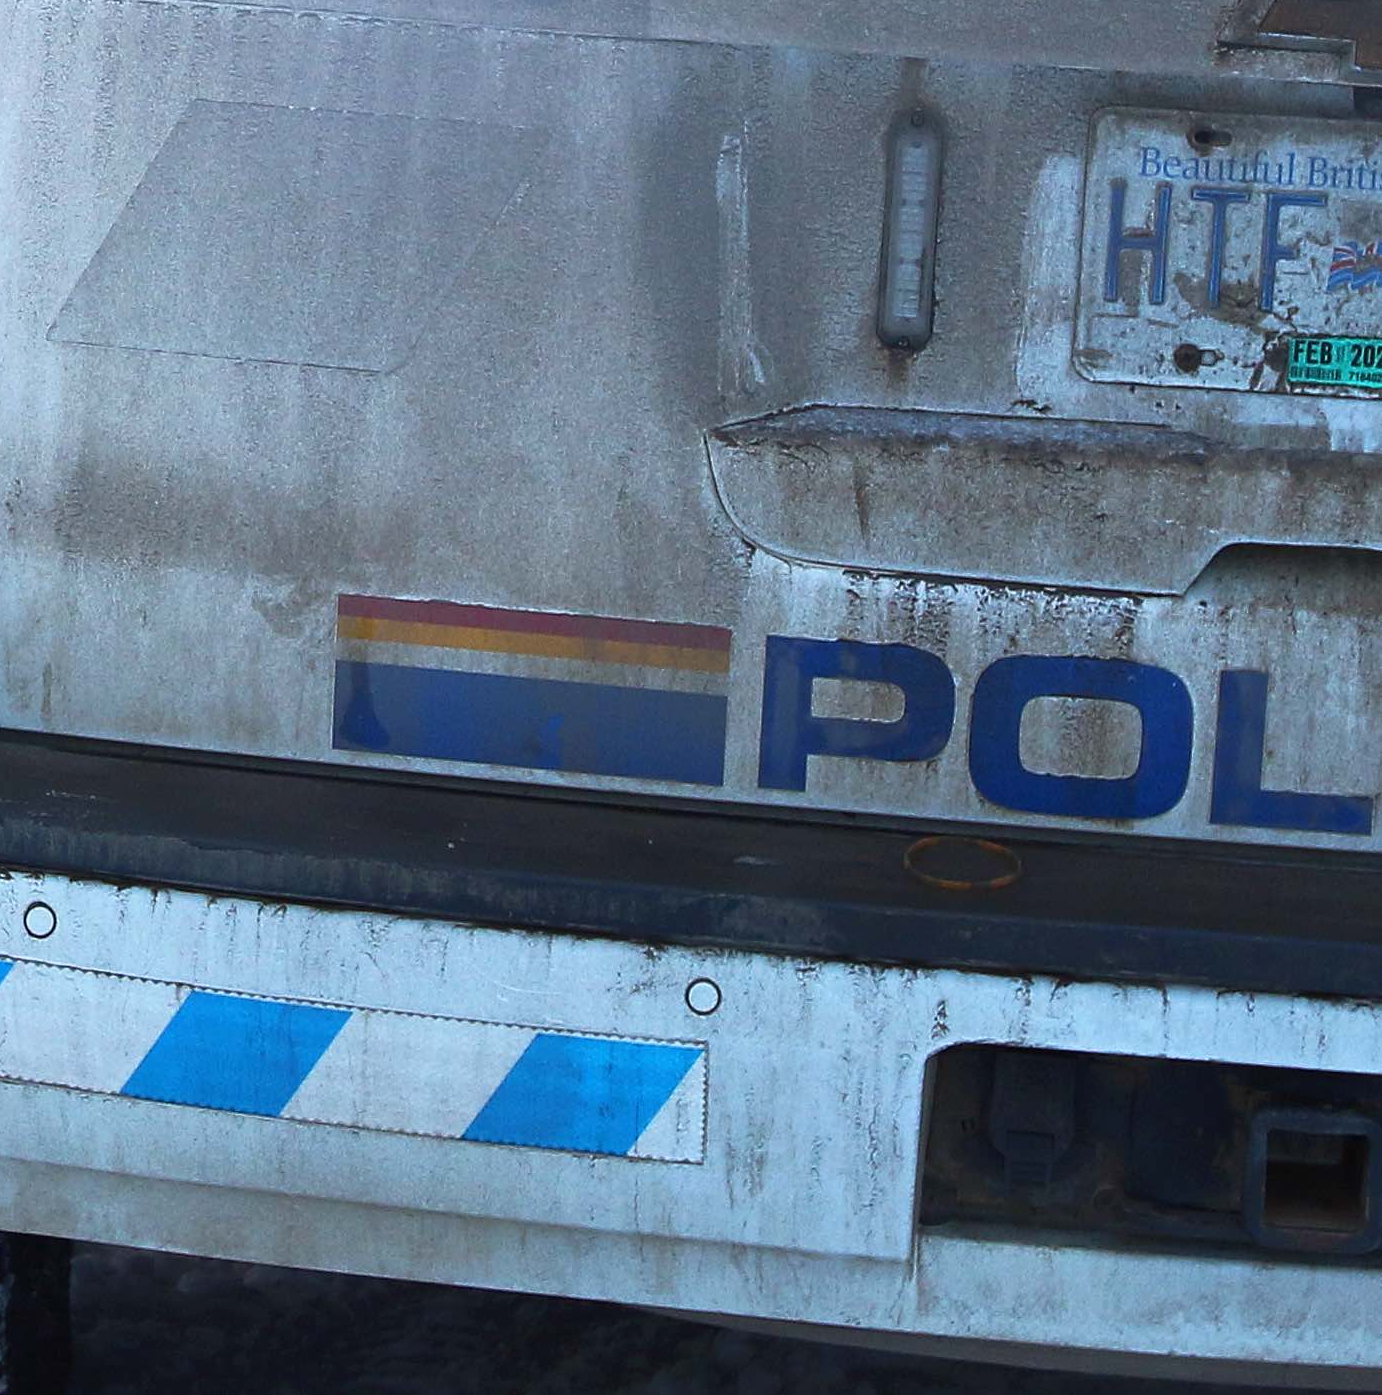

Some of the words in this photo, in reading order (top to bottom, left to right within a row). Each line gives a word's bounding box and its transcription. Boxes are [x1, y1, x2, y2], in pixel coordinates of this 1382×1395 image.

[1139, 146, 1296, 186] Beautiful
[1308, 155, 1382, 190] Briti
[1293, 340, 1334, 365] FEB
[758, 634, 1374, 835] POL
